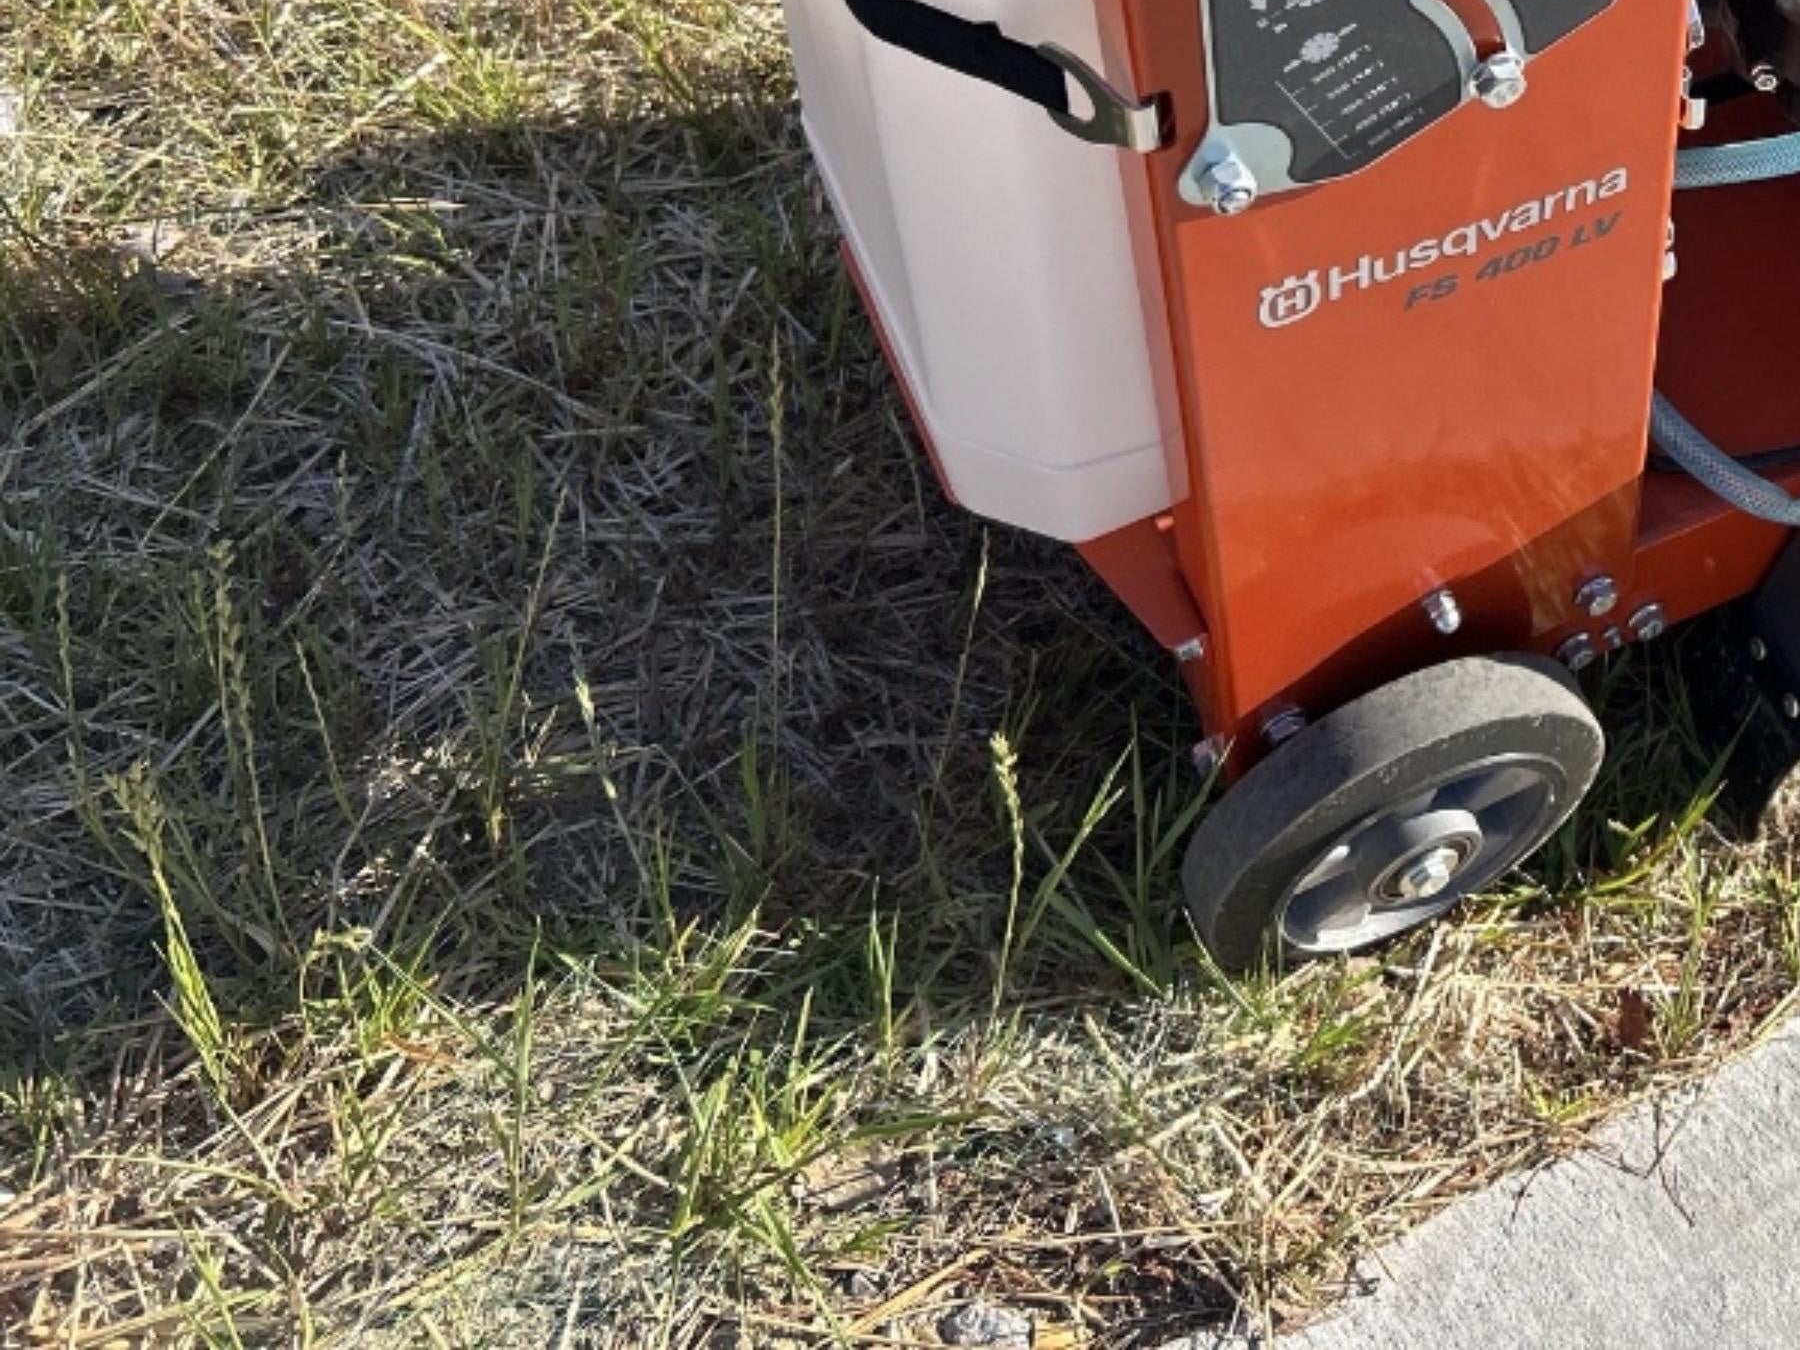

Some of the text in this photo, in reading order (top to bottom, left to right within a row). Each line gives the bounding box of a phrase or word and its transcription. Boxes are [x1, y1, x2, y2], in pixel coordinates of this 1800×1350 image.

[1328, 167, 1628, 301] Husqvarna
[1404, 211, 1622, 312] FS 400 LV
